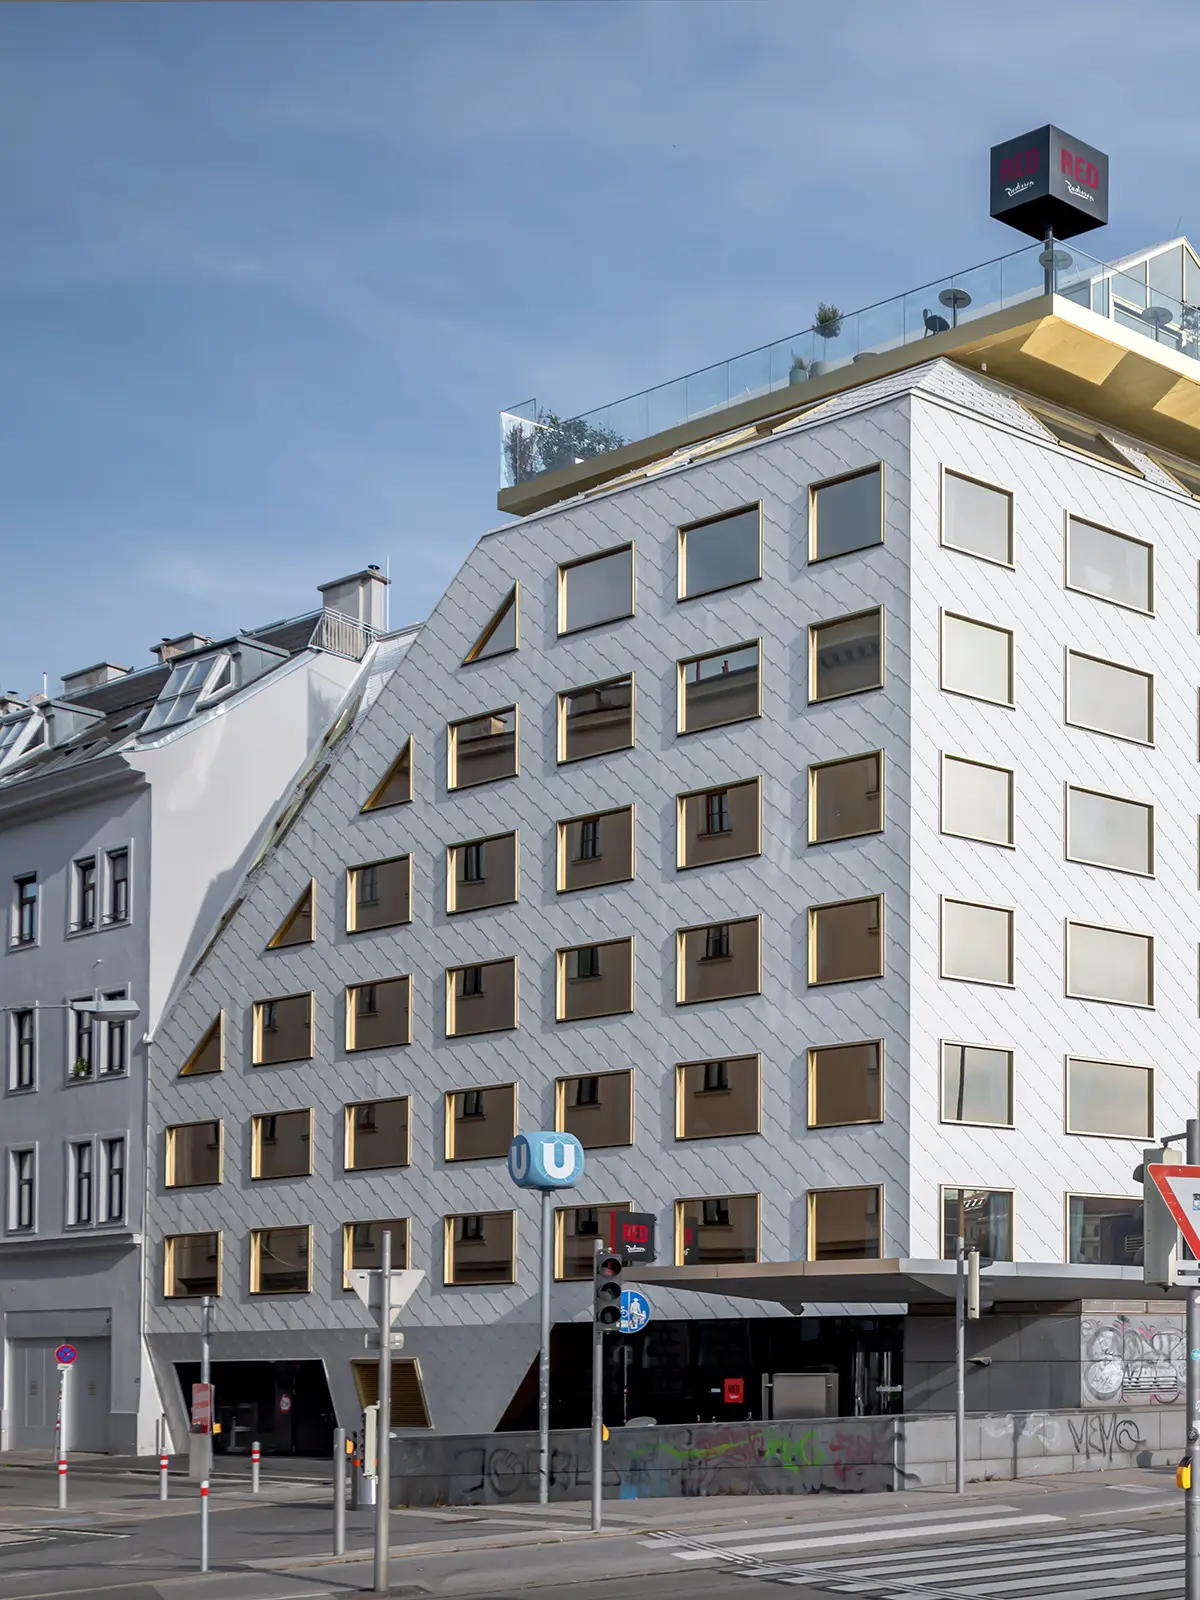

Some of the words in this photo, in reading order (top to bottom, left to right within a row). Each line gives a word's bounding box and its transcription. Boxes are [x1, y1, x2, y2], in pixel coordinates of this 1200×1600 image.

[1001, 148, 1038, 184] RED
[1061, 148, 1098, 190] RED
[511, 1143, 527, 1180] U
[542, 1142, 576, 1179] U
[622, 1223, 649, 1243] RED
